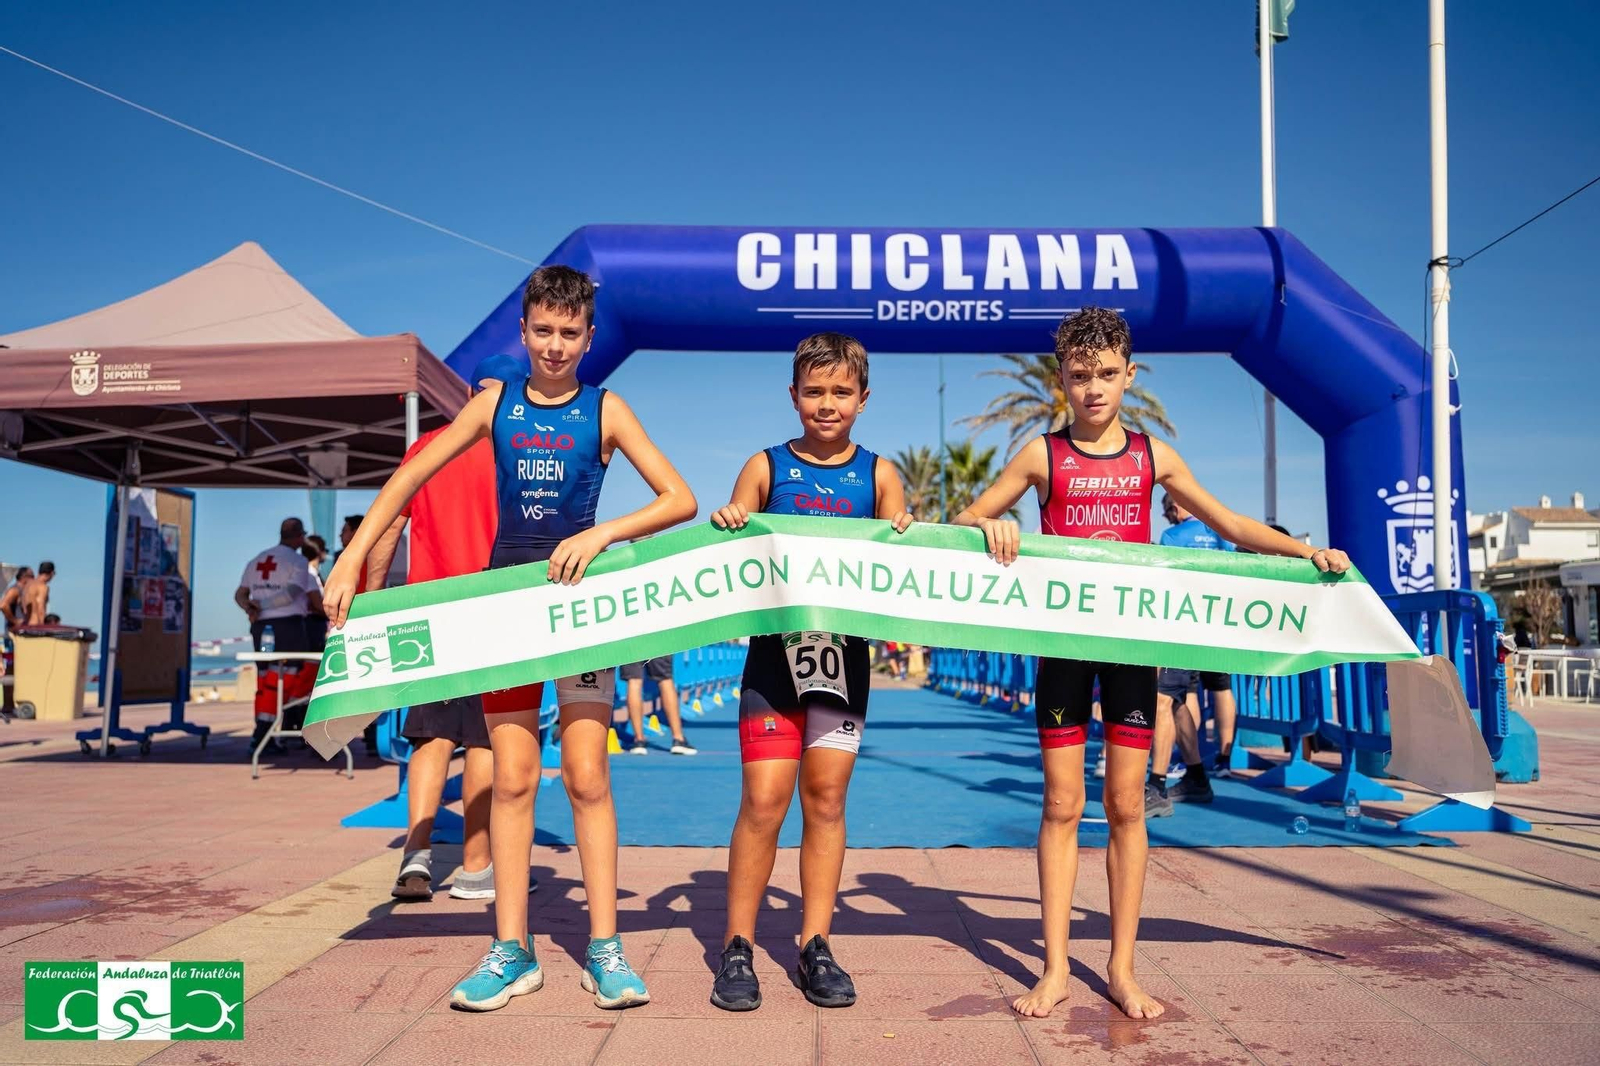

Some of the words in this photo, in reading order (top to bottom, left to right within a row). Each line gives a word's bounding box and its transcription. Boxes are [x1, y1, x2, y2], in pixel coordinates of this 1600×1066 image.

[736, 232, 1138, 291] CHICLANA
[877, 300, 1004, 321] DEPORTES
[103, 363, 142, 371] DELEGACIÓN
[103, 371, 149, 380] DEPORTES
[510, 432, 575, 450] GALO
[517, 456, 564, 482] RUBÉN
[839, 476, 865, 485] SPIRAL
[1068, 475, 1142, 489] ISBILYA
[521, 489, 559, 499] syngenta
[1066, 489, 1130, 498] TRIATHLON
[794, 493, 853, 515] GALO
[809, 509, 837, 518] SPORT
[1065, 500, 1142, 526] DOMÍNGUEZ
[548, 554, 790, 633] FEDERACION
[805, 556, 1028, 608] ANDALUZA
[1045, 580, 1096, 614] DE
[1112, 586, 1308, 634] TRIATLON
[347, 631, 387, 643] Andaluza
[387, 629, 397, 637] de
[397, 623, 428, 635] Triatlón
[795, 645, 840, 681] 50
